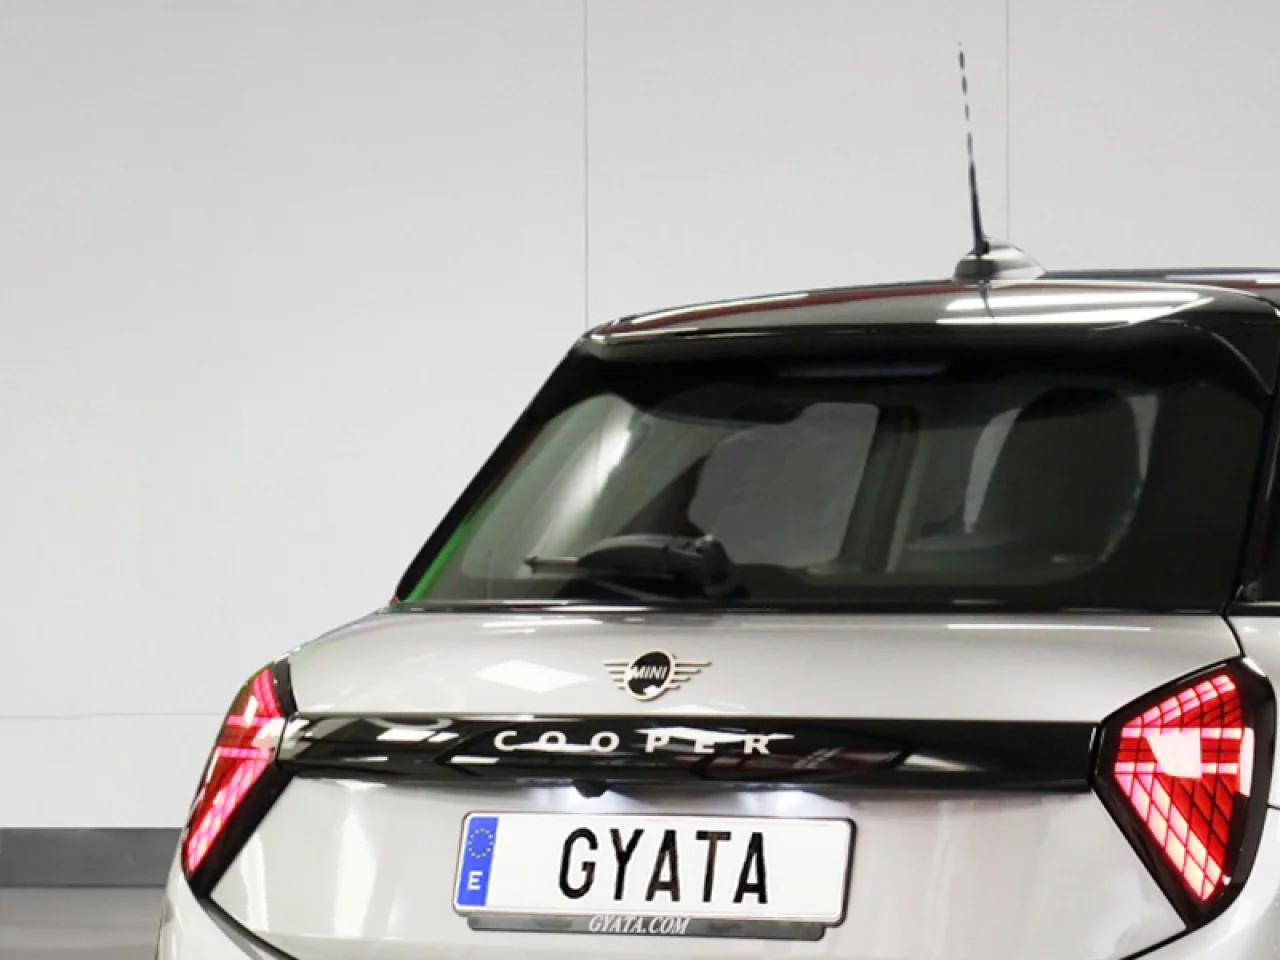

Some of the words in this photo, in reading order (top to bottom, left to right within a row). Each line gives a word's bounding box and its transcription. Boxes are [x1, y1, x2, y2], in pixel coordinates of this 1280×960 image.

[631, 665, 668, 680] MINI
[493, 731, 771, 754] COOPER
[558, 827, 768, 904] GYATA
[467, 870, 484, 890] E
[588, 914, 690, 934] GYATA.COM
